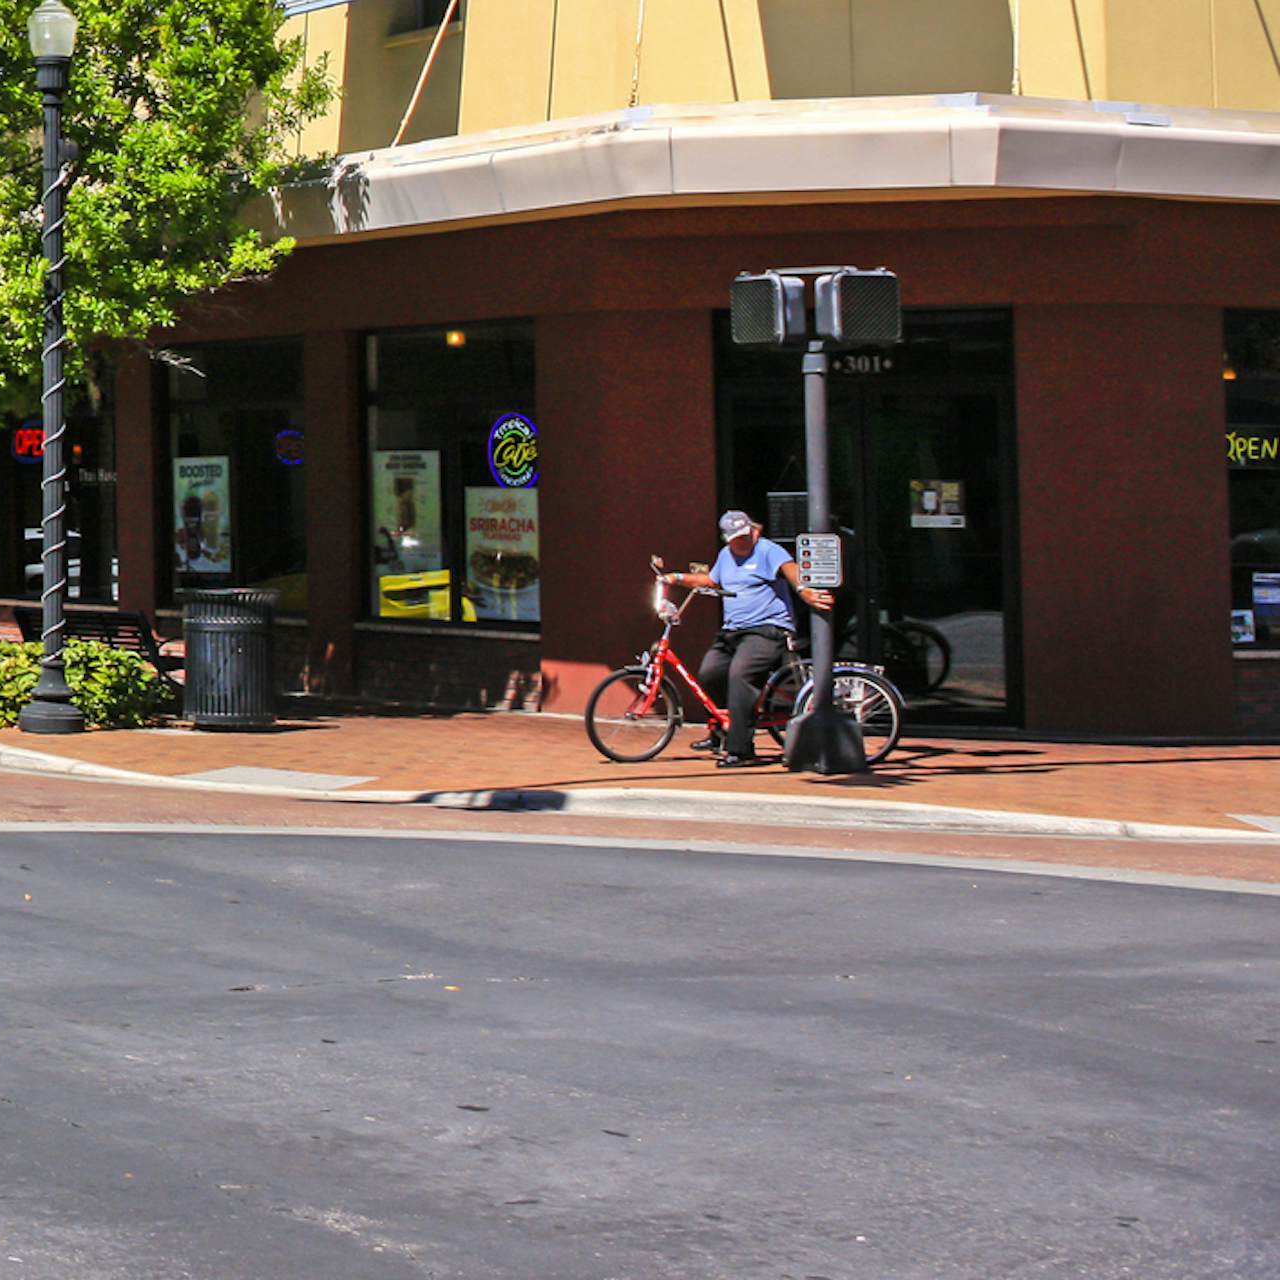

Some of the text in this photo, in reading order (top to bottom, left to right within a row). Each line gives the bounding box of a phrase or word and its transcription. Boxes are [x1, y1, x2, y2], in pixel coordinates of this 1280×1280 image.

[843, 354, 880, 373] 301
[179, 464, 223, 479] BOOSTED
[469, 517, 536, 533] SRIRACHA
